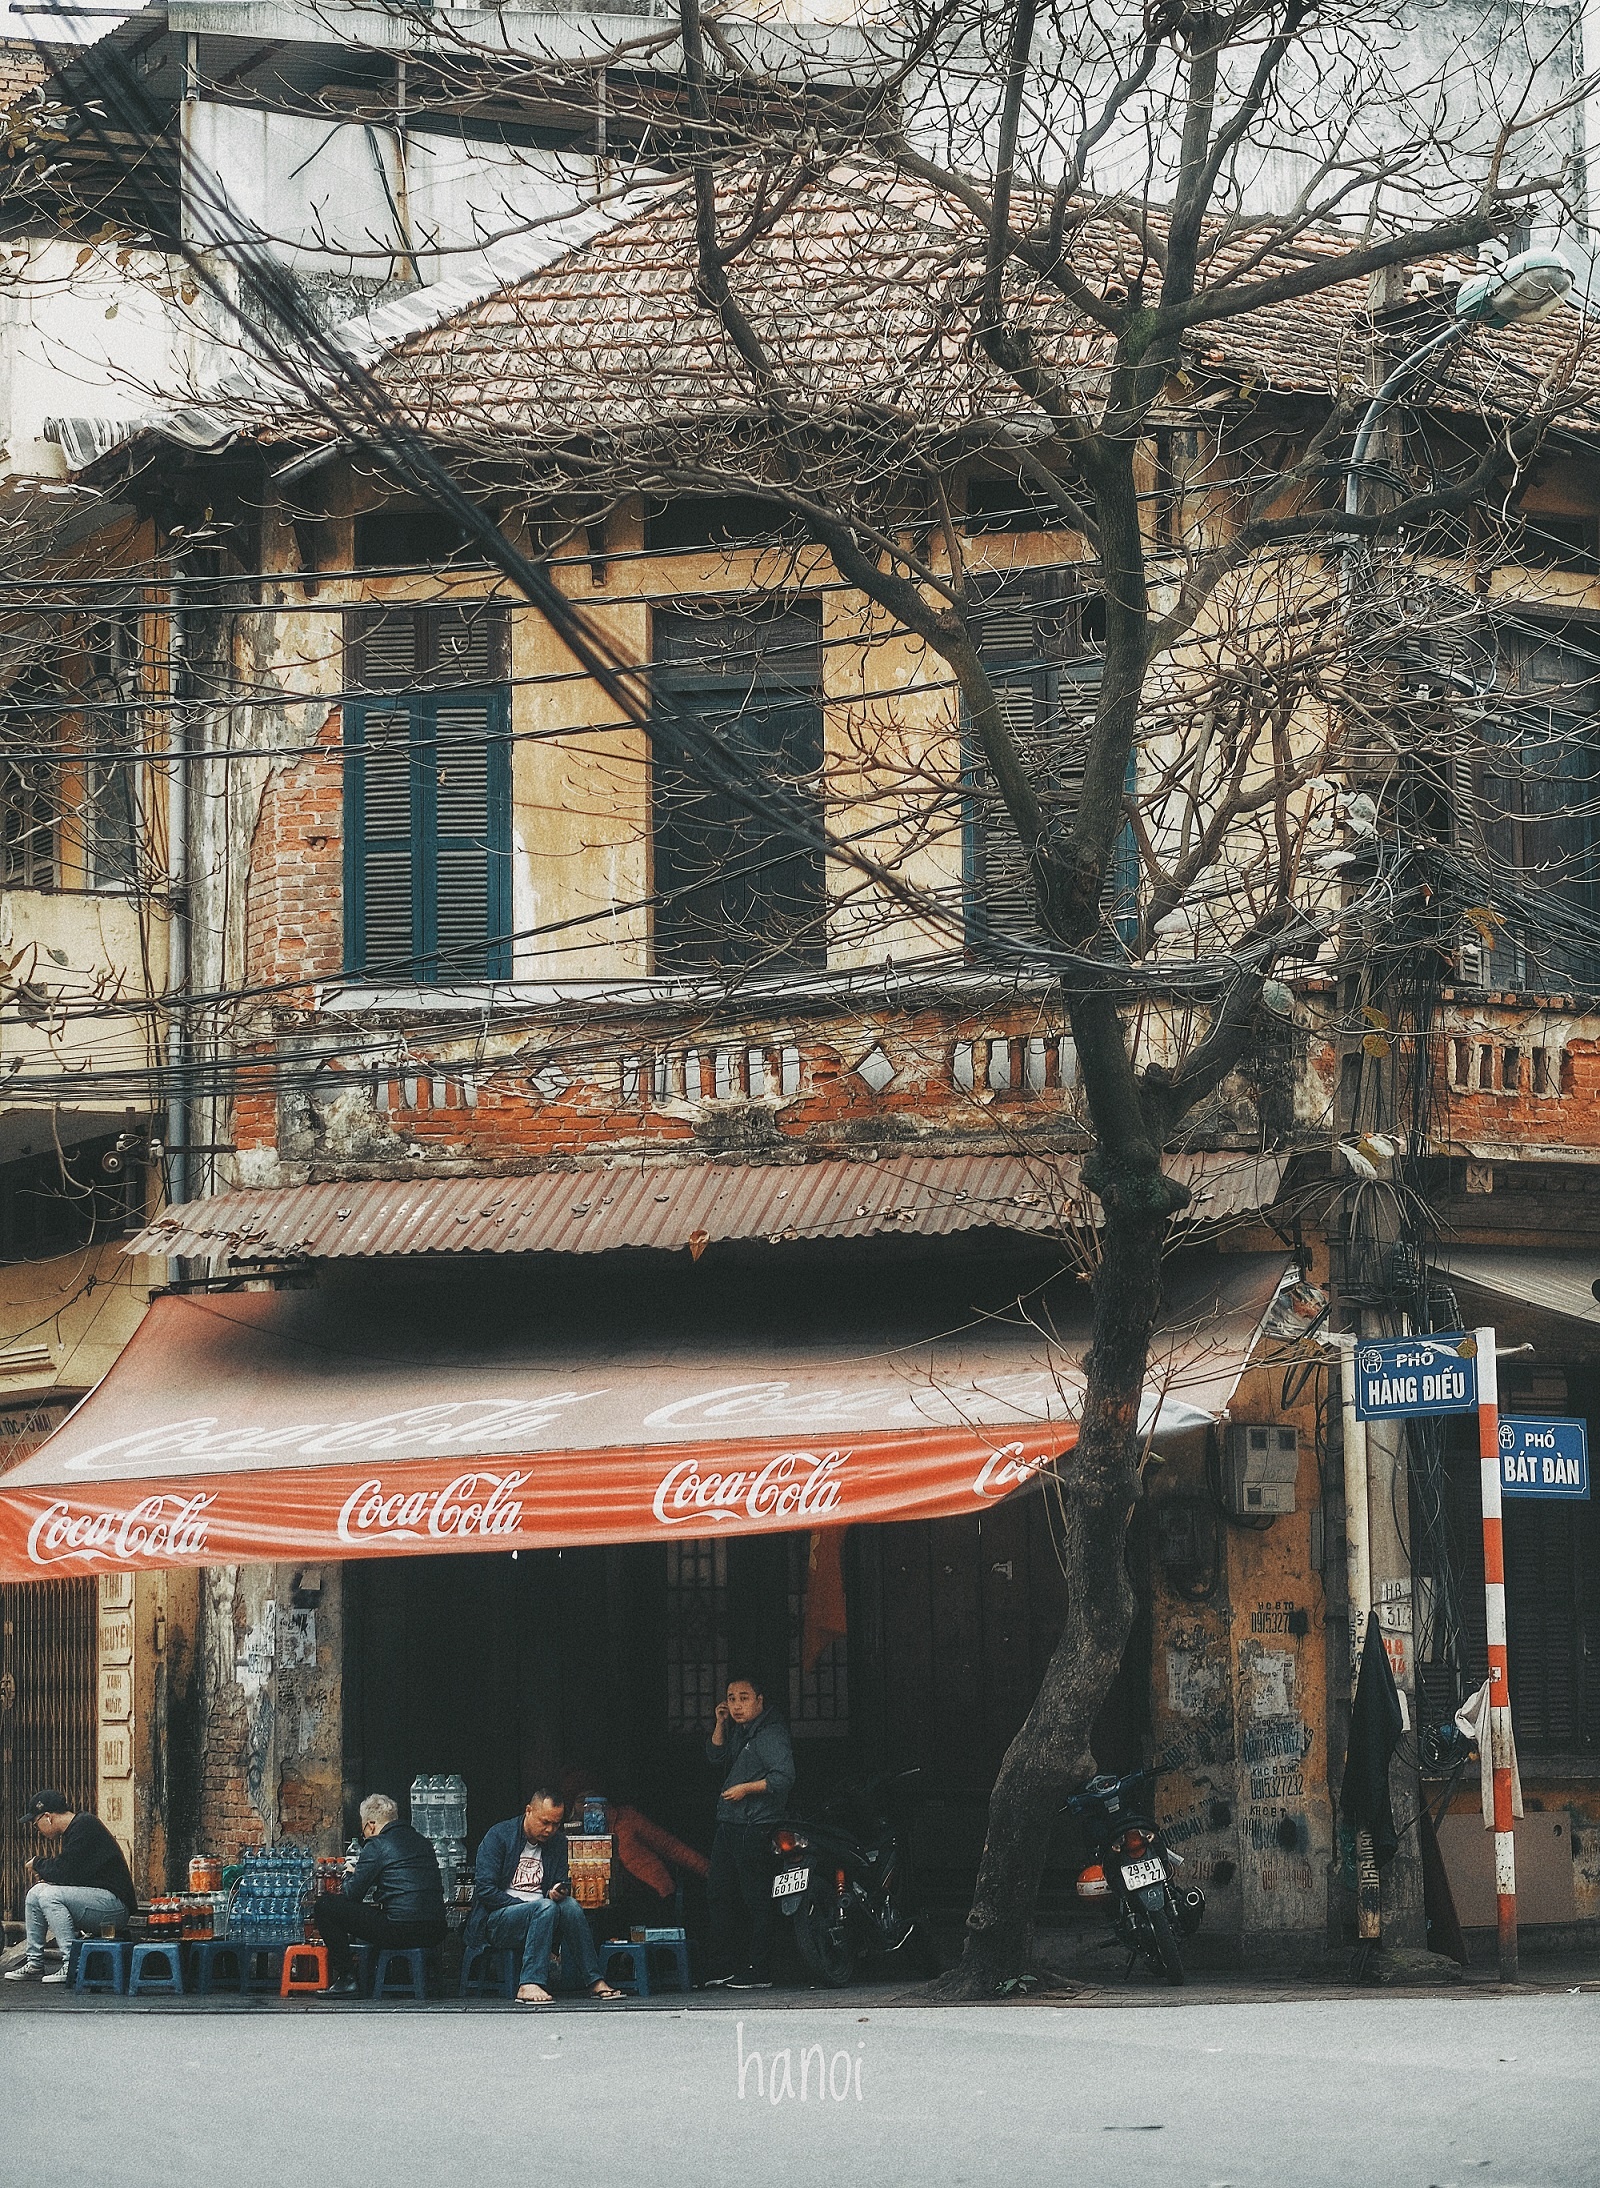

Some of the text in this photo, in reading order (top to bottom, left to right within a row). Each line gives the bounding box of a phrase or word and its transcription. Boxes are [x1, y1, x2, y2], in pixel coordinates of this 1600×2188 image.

[1368, 1366, 1466, 1406] HÀNG ĐIẾU
[1525, 1428, 1555, 1448] PHỐ
[1504, 1451, 1580, 1485] BÁT ĐÀN
[653, 1450, 852, 1523] Coca-Cola
[337, 1469, 534, 1542] Coca-Cola
[27, 1492, 219, 1565] Coca-Cola
[779, 1871, 803, 1884] 29-C1
[1127, 1860, 1156, 1876] 29-B1
[775, 1880, 806, 1895] 601.06
